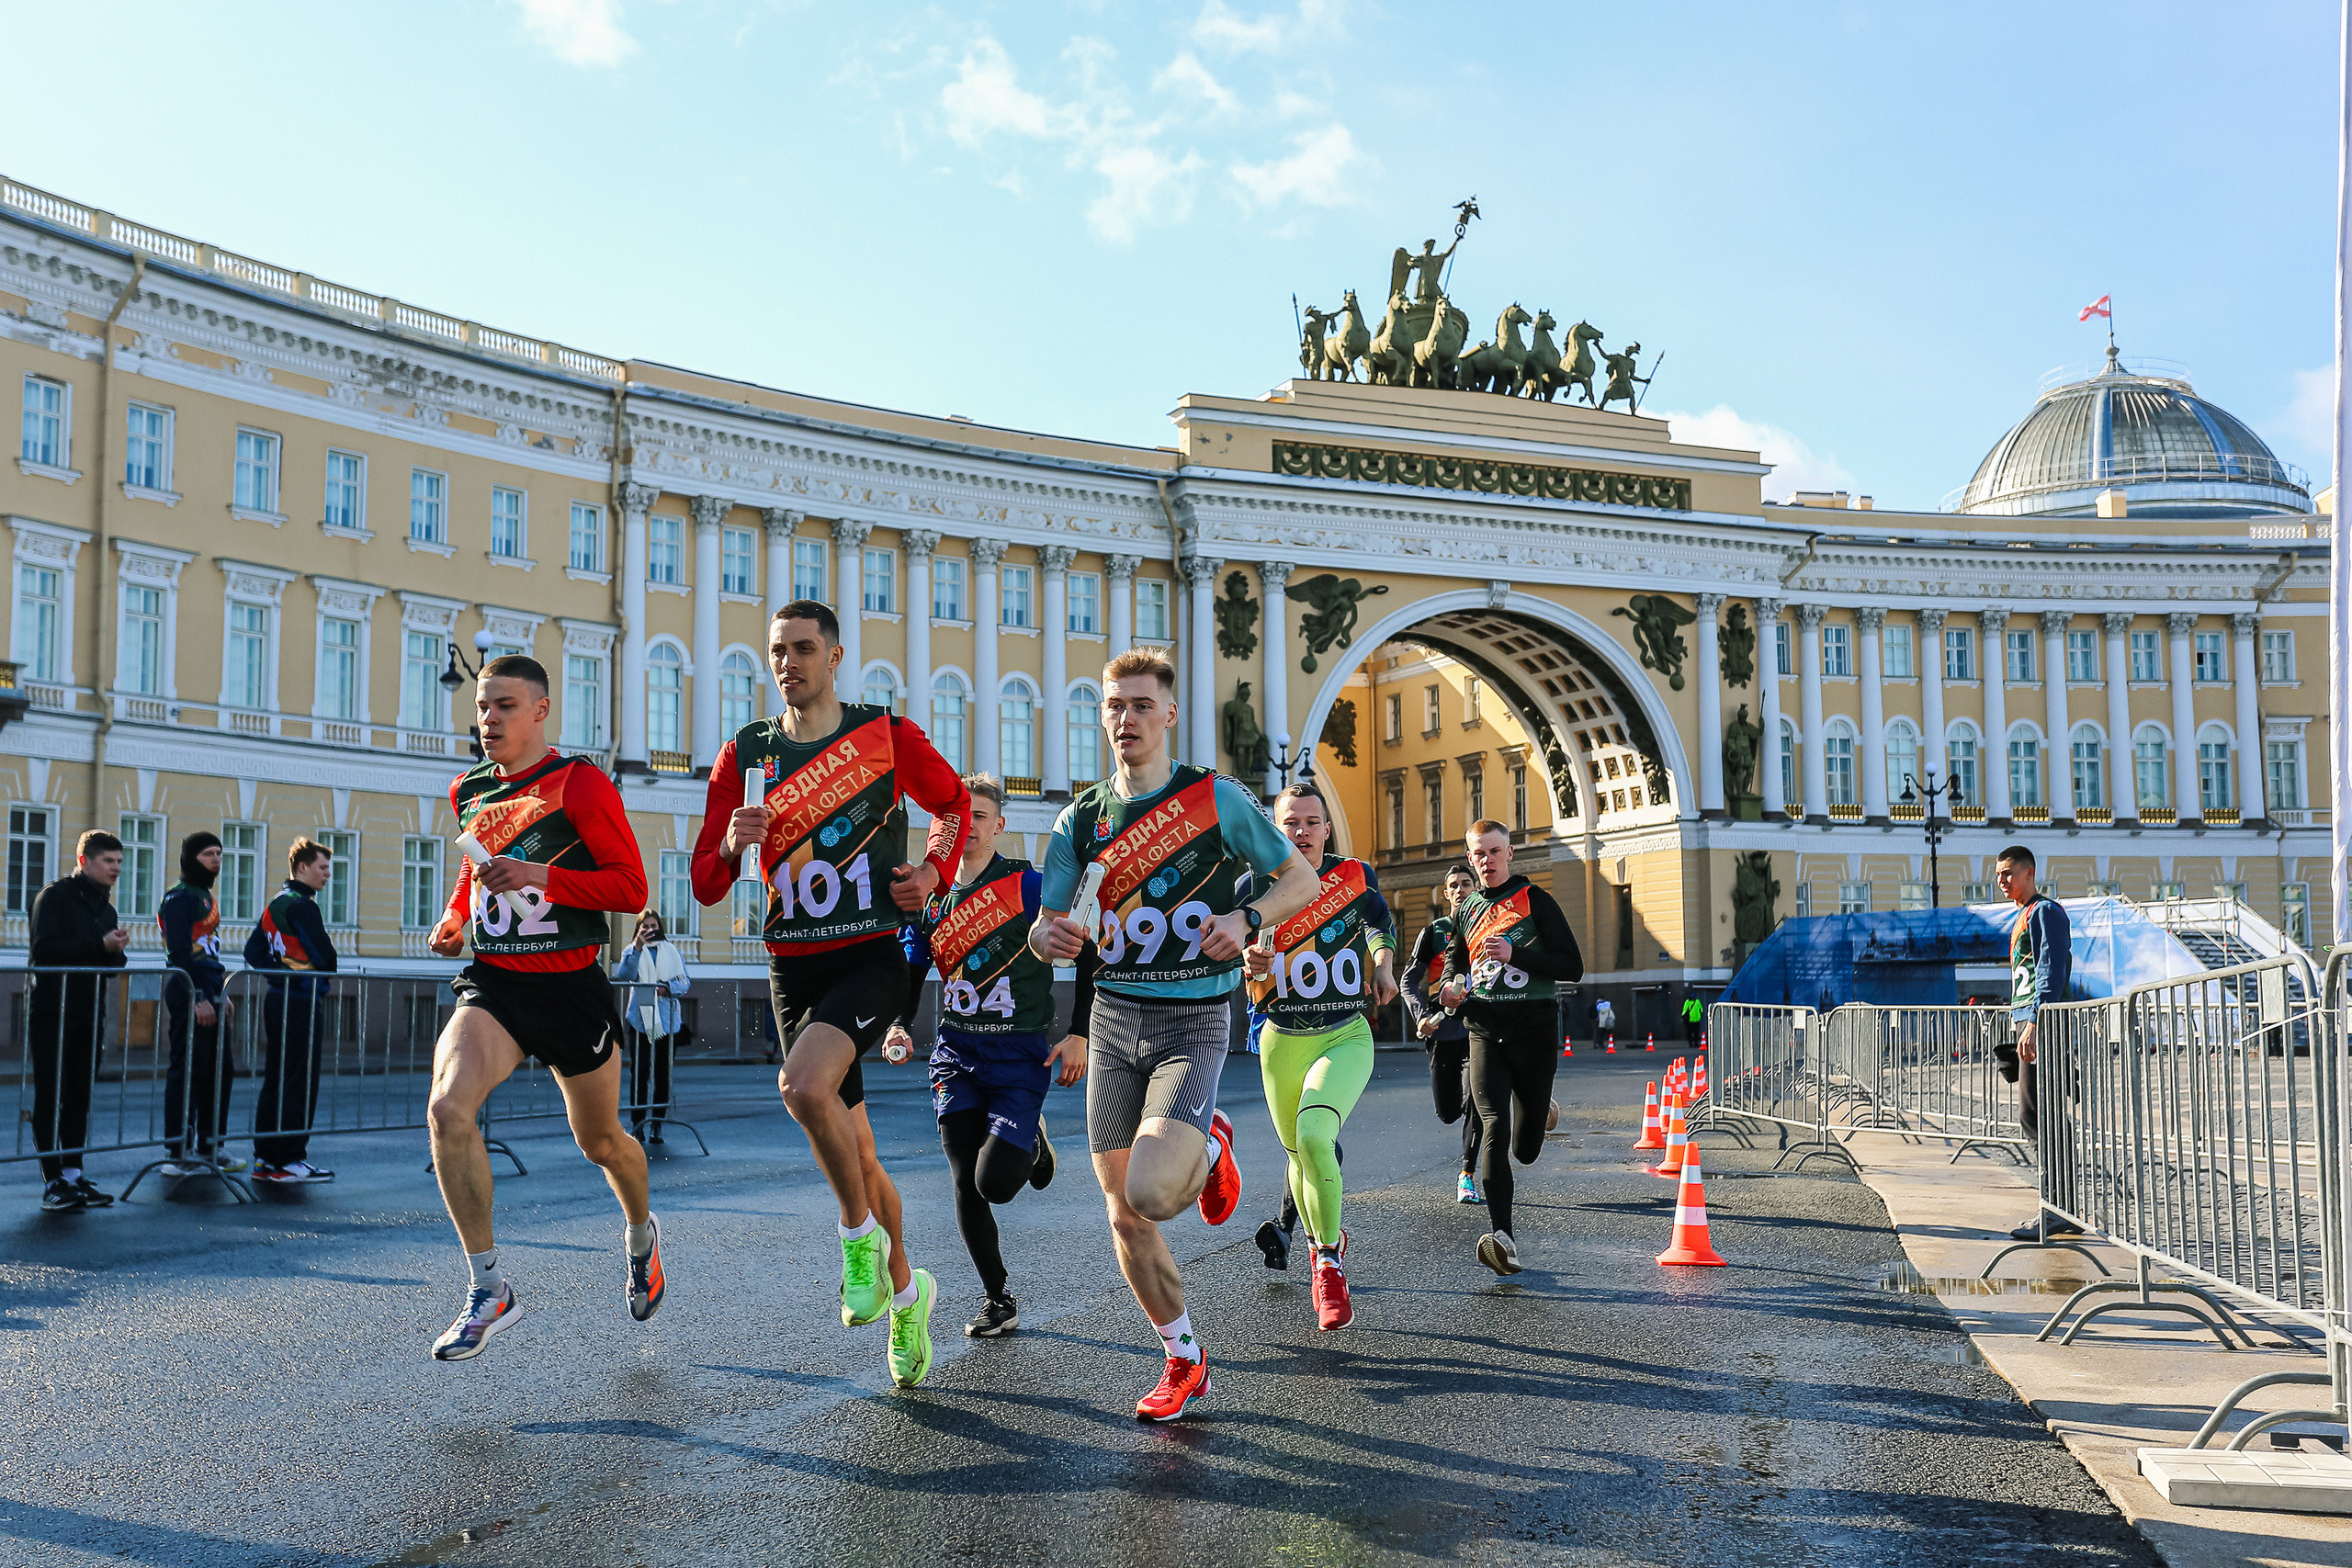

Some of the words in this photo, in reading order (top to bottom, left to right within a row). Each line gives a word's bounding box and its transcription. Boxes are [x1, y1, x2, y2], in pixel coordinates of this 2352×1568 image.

[772, 764, 876, 852] ЭСТАФЕТА
[774, 852, 872, 919] 101
[1107, 819, 1200, 902] ЭСТАФЕТА
[469, 884, 559, 937] 02
[774, 919, 878, 939] САНКТ-ПЕТЕРБУРГ
[944, 908, 1009, 966] СТАФЕТА
[1281, 886, 1357, 945] ЭСТАФЕТА
[1104, 965, 1209, 980] САНКТ-ПЕТЕРБУРГ
[1271, 947, 1362, 998] 100
[1471, 958, 1530, 989] 98
[2012, 965, 2031, 998] 2
